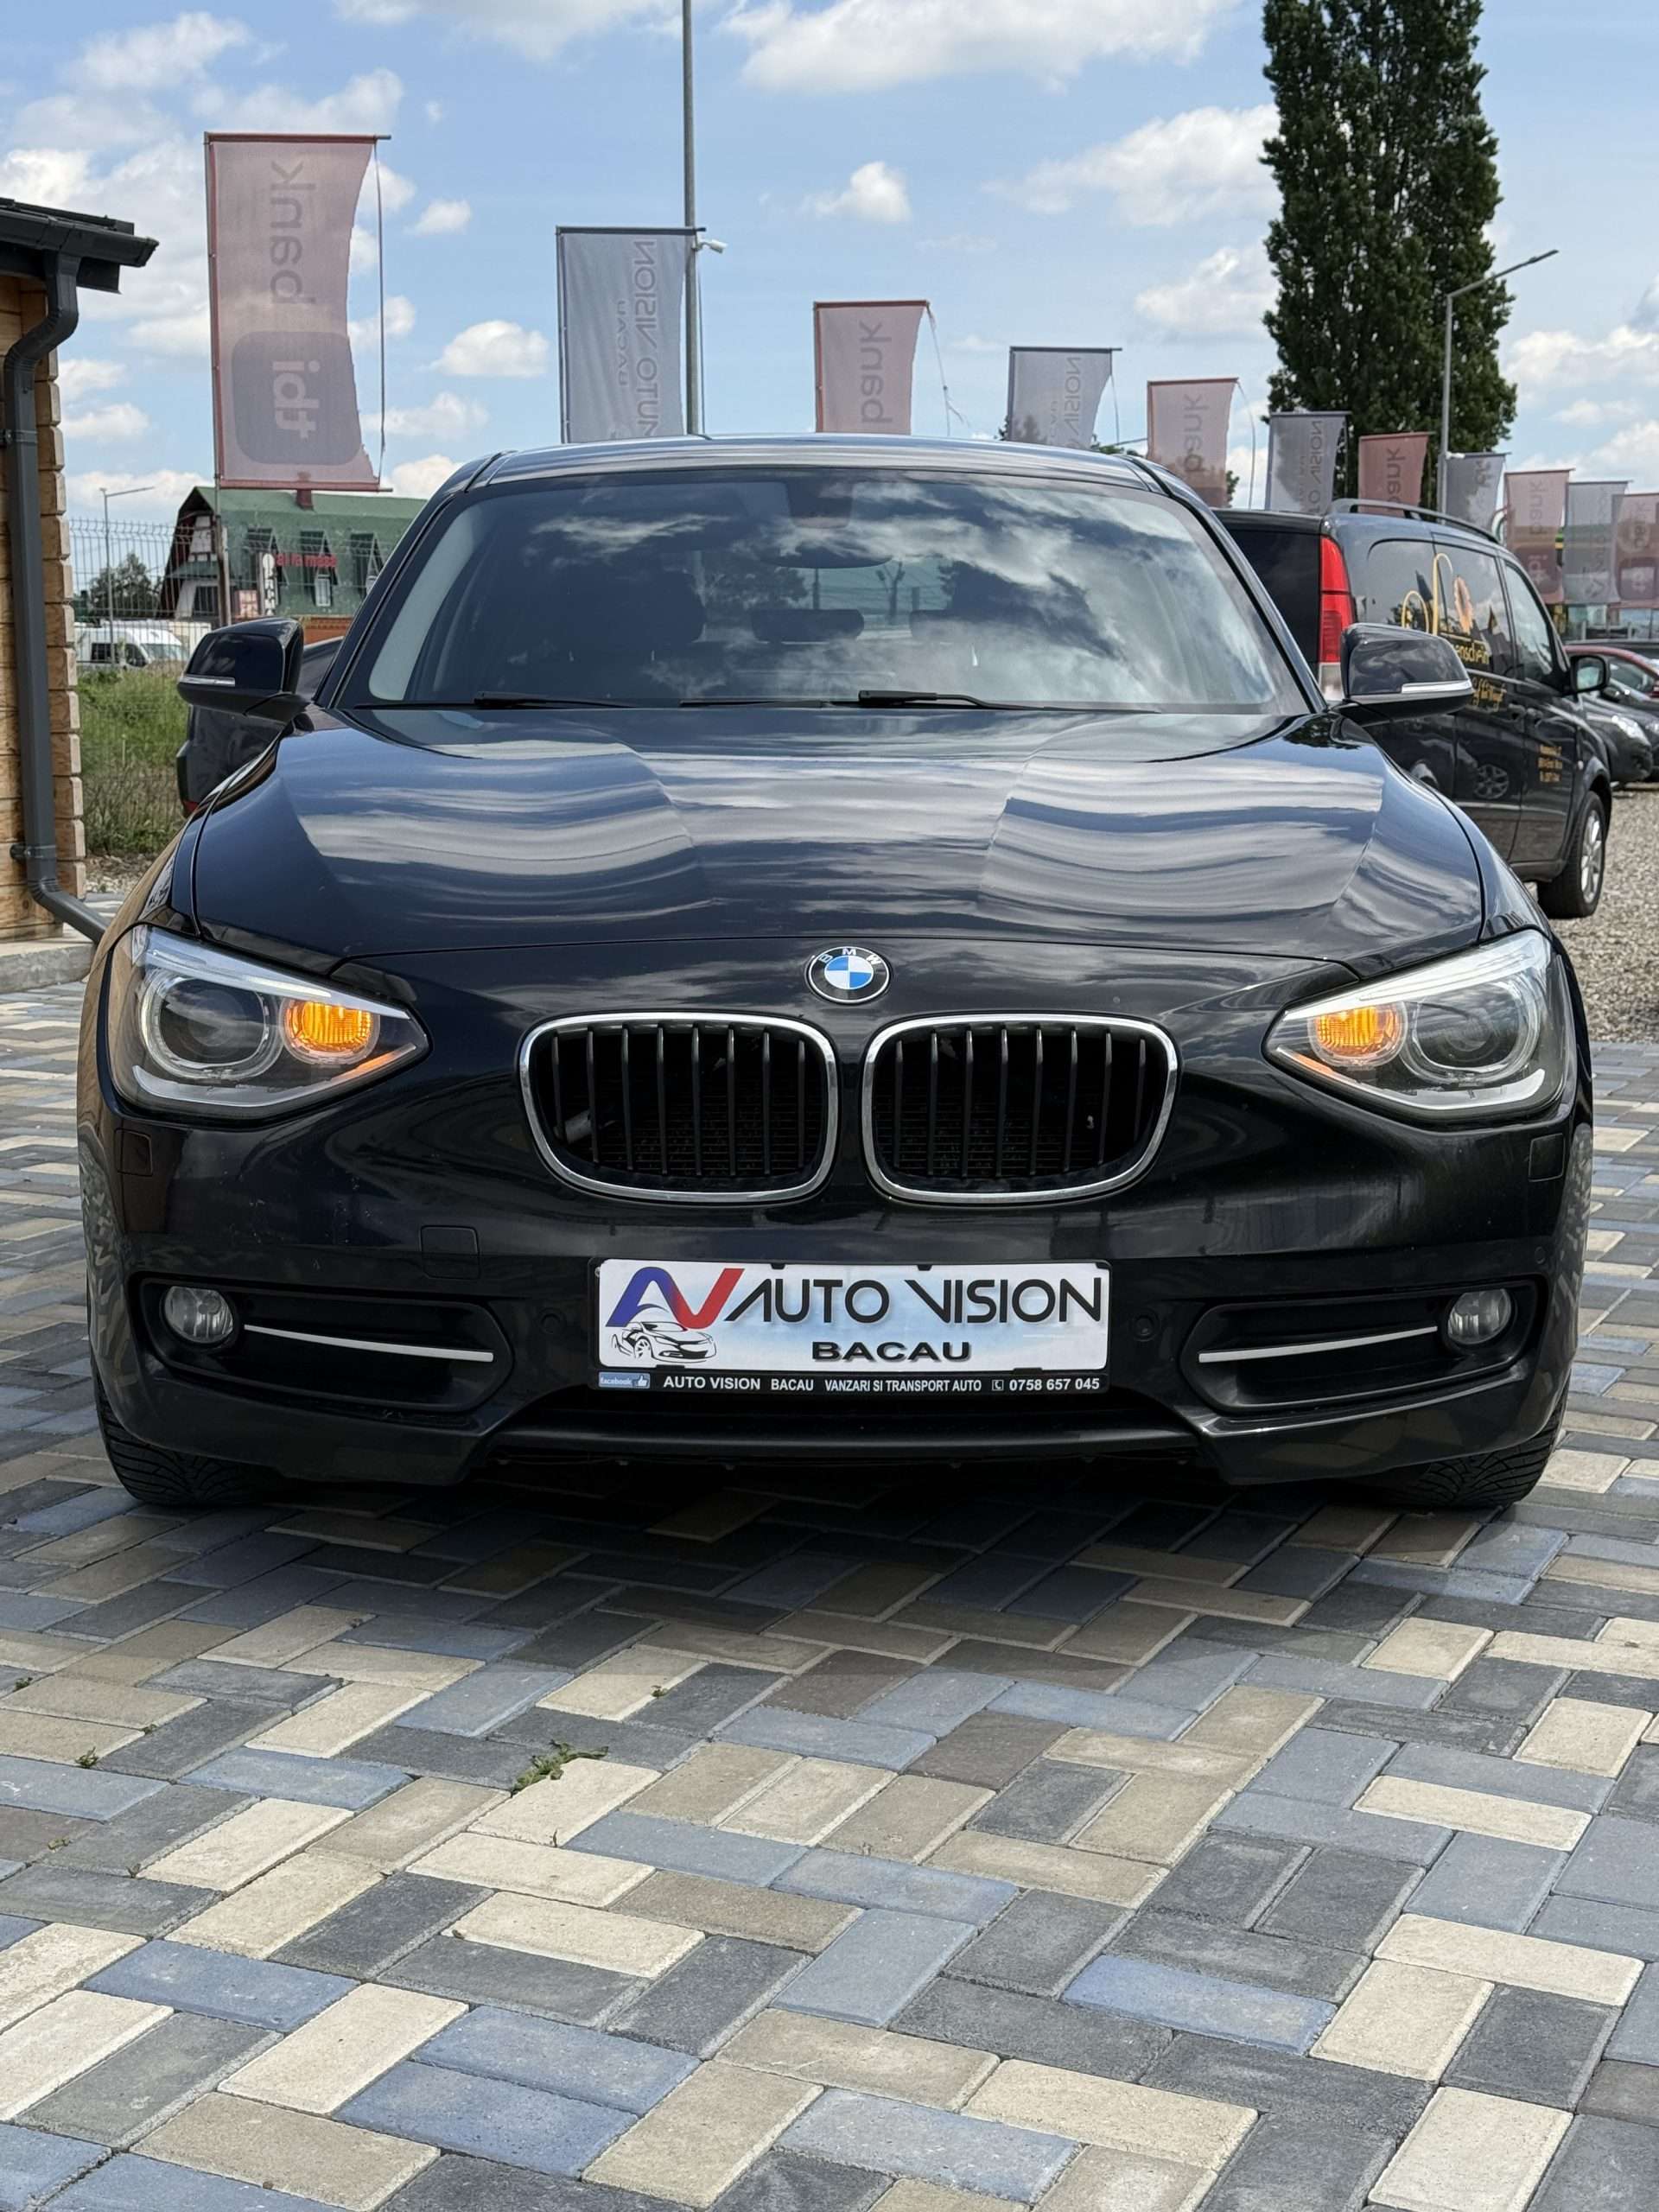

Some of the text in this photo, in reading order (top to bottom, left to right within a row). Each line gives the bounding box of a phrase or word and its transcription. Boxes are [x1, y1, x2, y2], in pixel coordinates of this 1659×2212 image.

[818, 948, 882, 965] BMW
[723, 1277, 1103, 1324] AUTO VISION
[811, 1341, 972, 1362] BACAU
[663, 1376, 1100, 1392] AUTO VISION BACAU VANZARI SI TRANSPORT AUTO 0758 657 045
